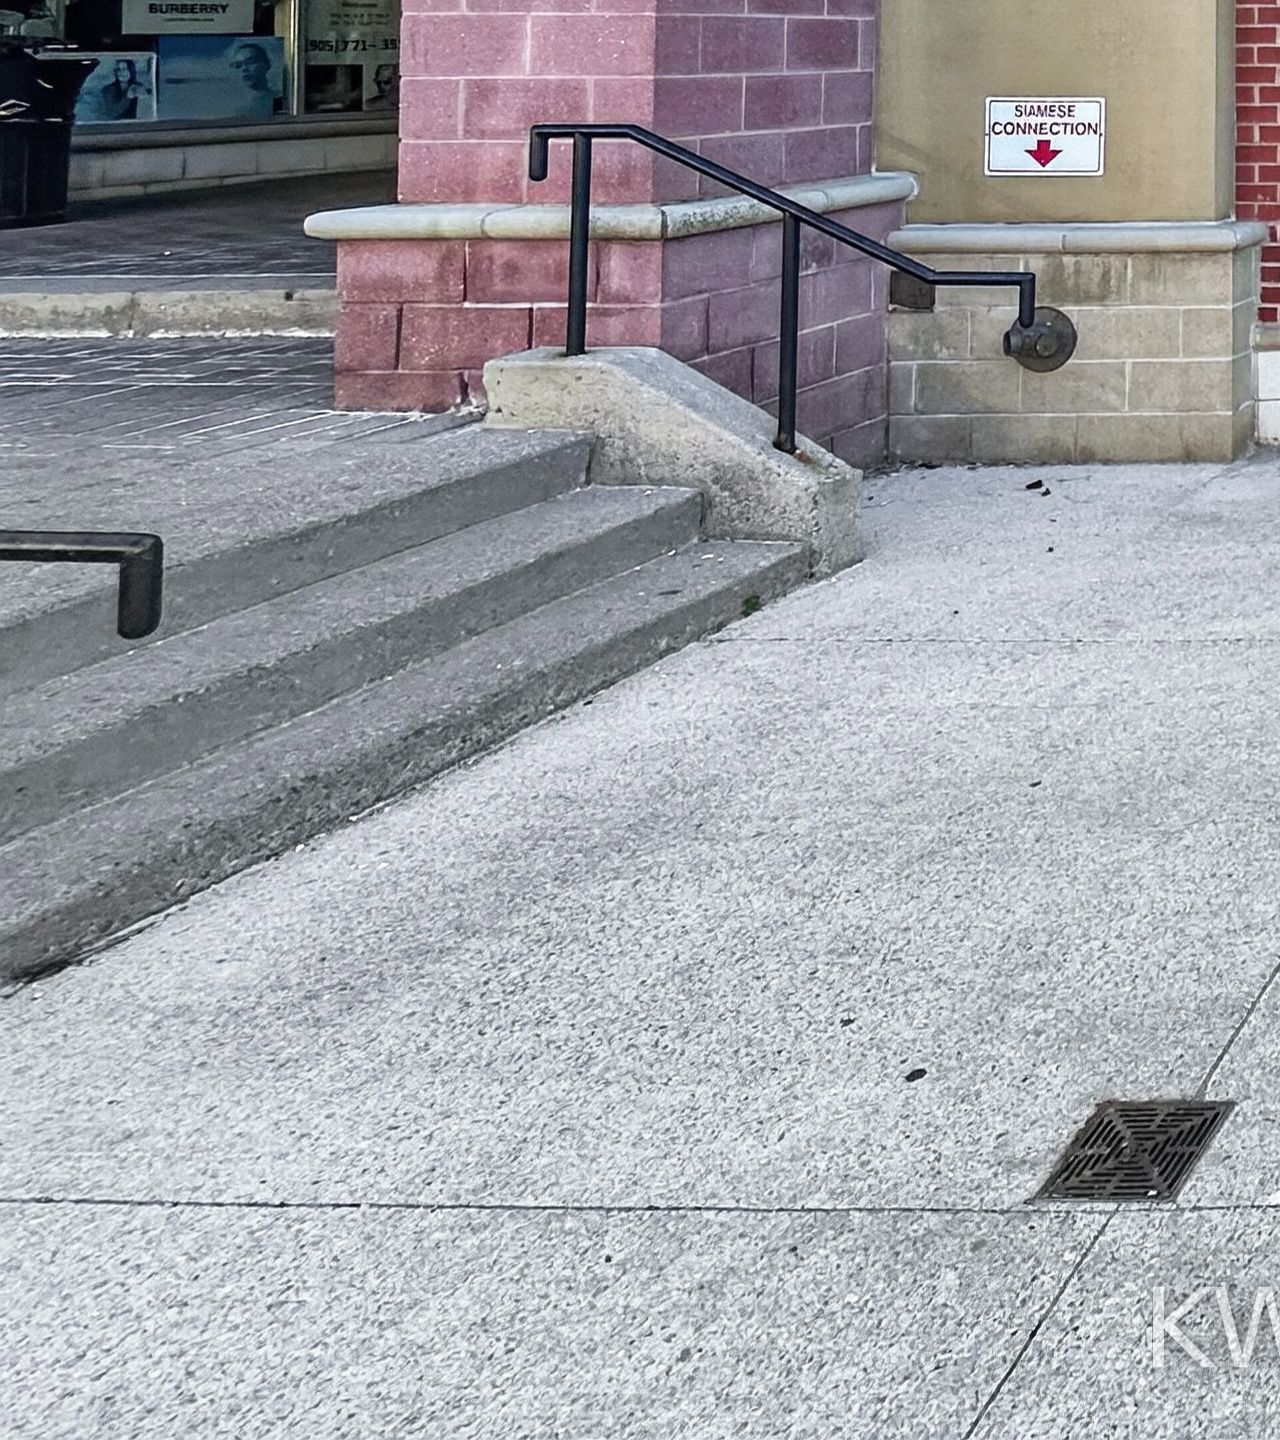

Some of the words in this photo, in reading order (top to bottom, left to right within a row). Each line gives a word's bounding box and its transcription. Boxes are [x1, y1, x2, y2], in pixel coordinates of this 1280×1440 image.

[148, 3, 229, 15] BURBERRY
[1014, 104, 1076, 118] SIAMESE
[991, 122, 1098, 135] CONNECTION
